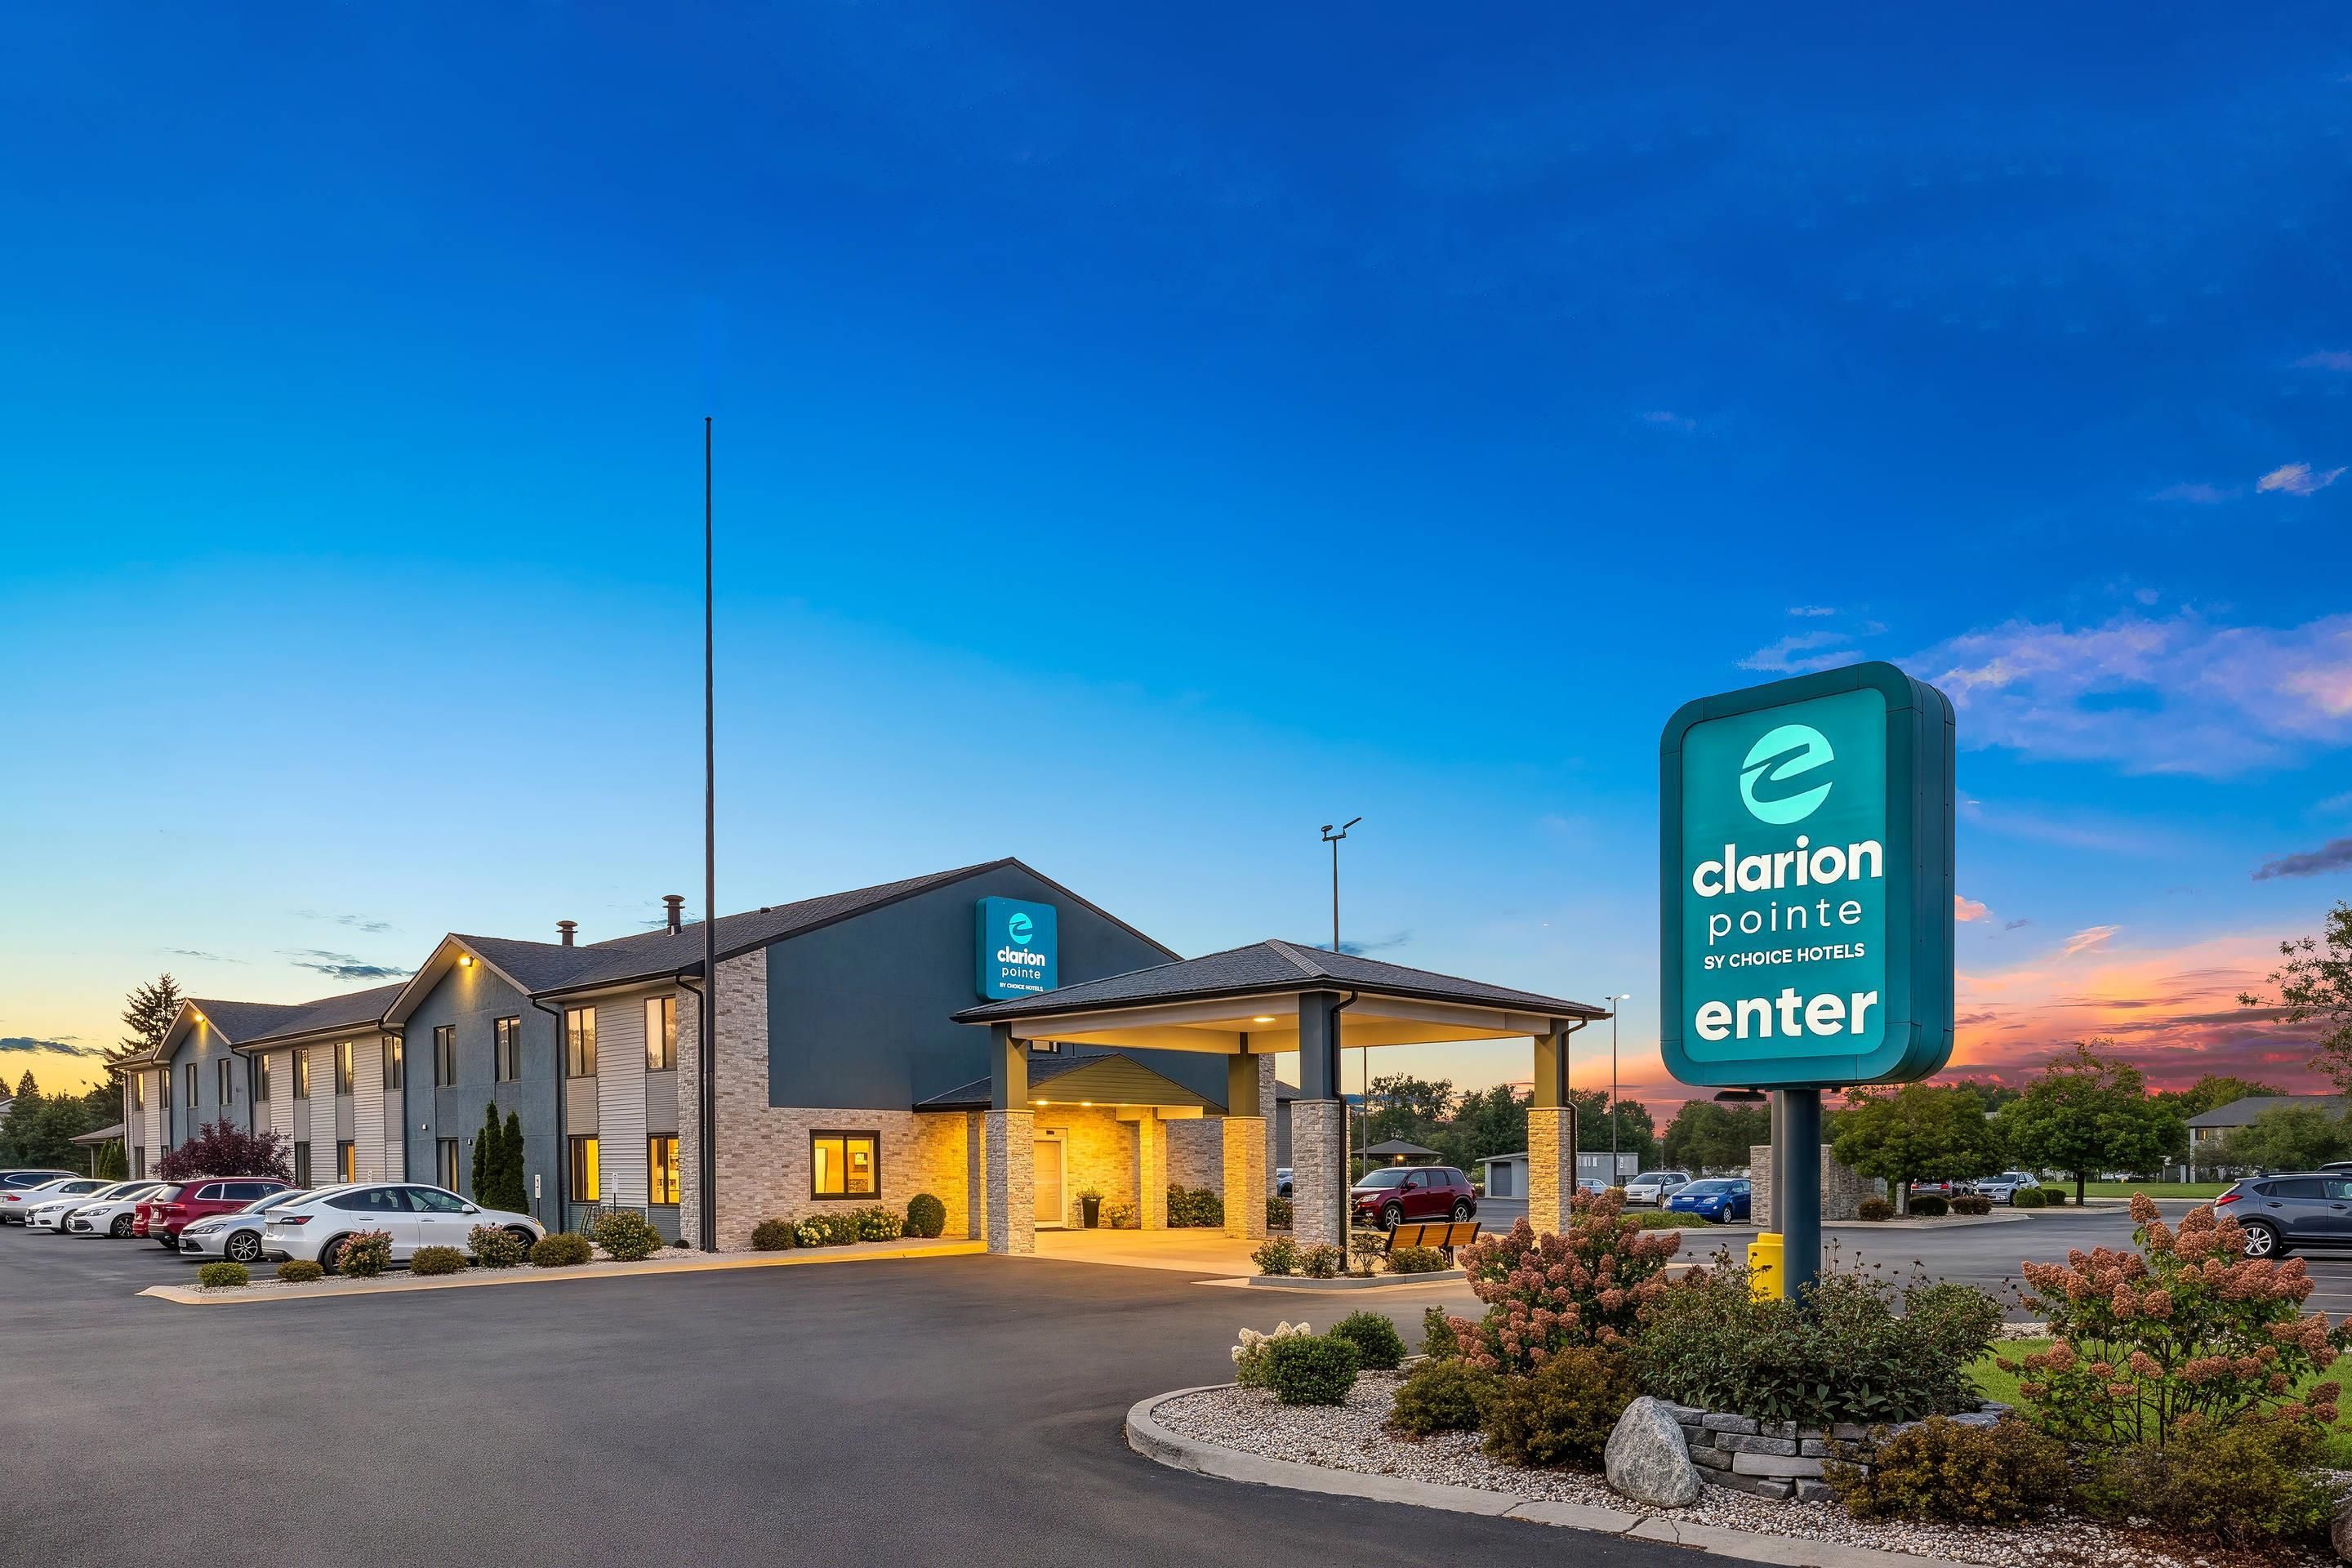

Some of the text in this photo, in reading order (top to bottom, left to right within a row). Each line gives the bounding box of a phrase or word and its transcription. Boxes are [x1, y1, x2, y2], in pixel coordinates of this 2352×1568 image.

[1692, 835, 1883, 898] clarion
[1708, 898, 1862, 946] pointe
[997, 945, 1045, 967] clarion
[1001, 967, 1041, 979] pointe
[1729, 949, 1793, 968] CHOICE
[1797, 942, 1865, 962] HOTELS
[1695, 987, 1878, 1041] enter
